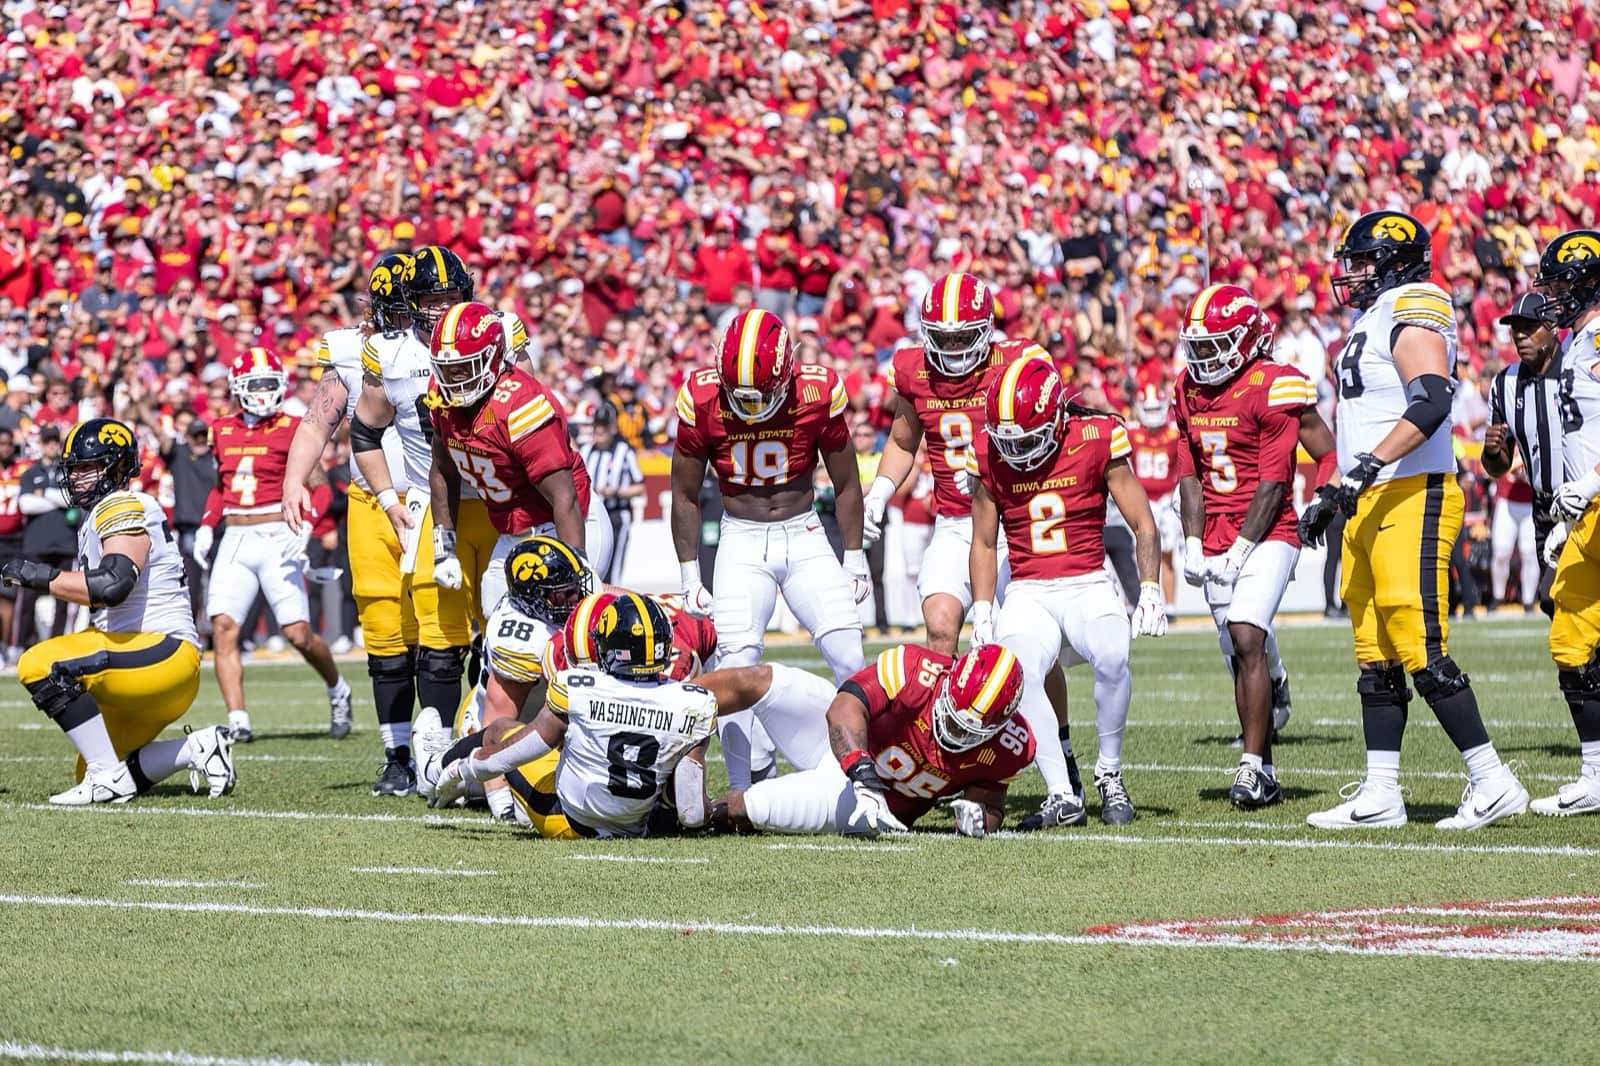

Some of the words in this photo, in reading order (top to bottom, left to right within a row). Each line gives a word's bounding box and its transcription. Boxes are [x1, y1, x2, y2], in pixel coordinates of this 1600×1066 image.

[801, 365, 828, 383] 19
[1335, 331, 1367, 403] 9
[926, 399, 950, 409] IOWA
[952, 397, 986, 409] STATE
[1516, 398, 1524, 409] S
[1191, 417, 1208, 427] IOWA
[1210, 417, 1239, 427] STATE
[758, 429, 794, 440] STATE
[728, 440, 790, 486] 19
[1200, 431, 1238, 493] 3
[231, 456, 257, 506] 4
[1012, 484, 1040, 494] IOWA
[1041, 476, 1077, 490] STATE
[1028, 492, 1068, 553] 2
[497, 619, 534, 642] 88
[655, 642, 664, 660] 8
[567, 675, 595, 688] 8
[682, 683, 708, 696] 8
[589, 700, 674, 732] WASHINGTON
[678, 712, 697, 735] JR
[1000, 720, 1028, 756] 95
[606, 731, 660, 799] 8
[875, 745, 951, 799] 95
